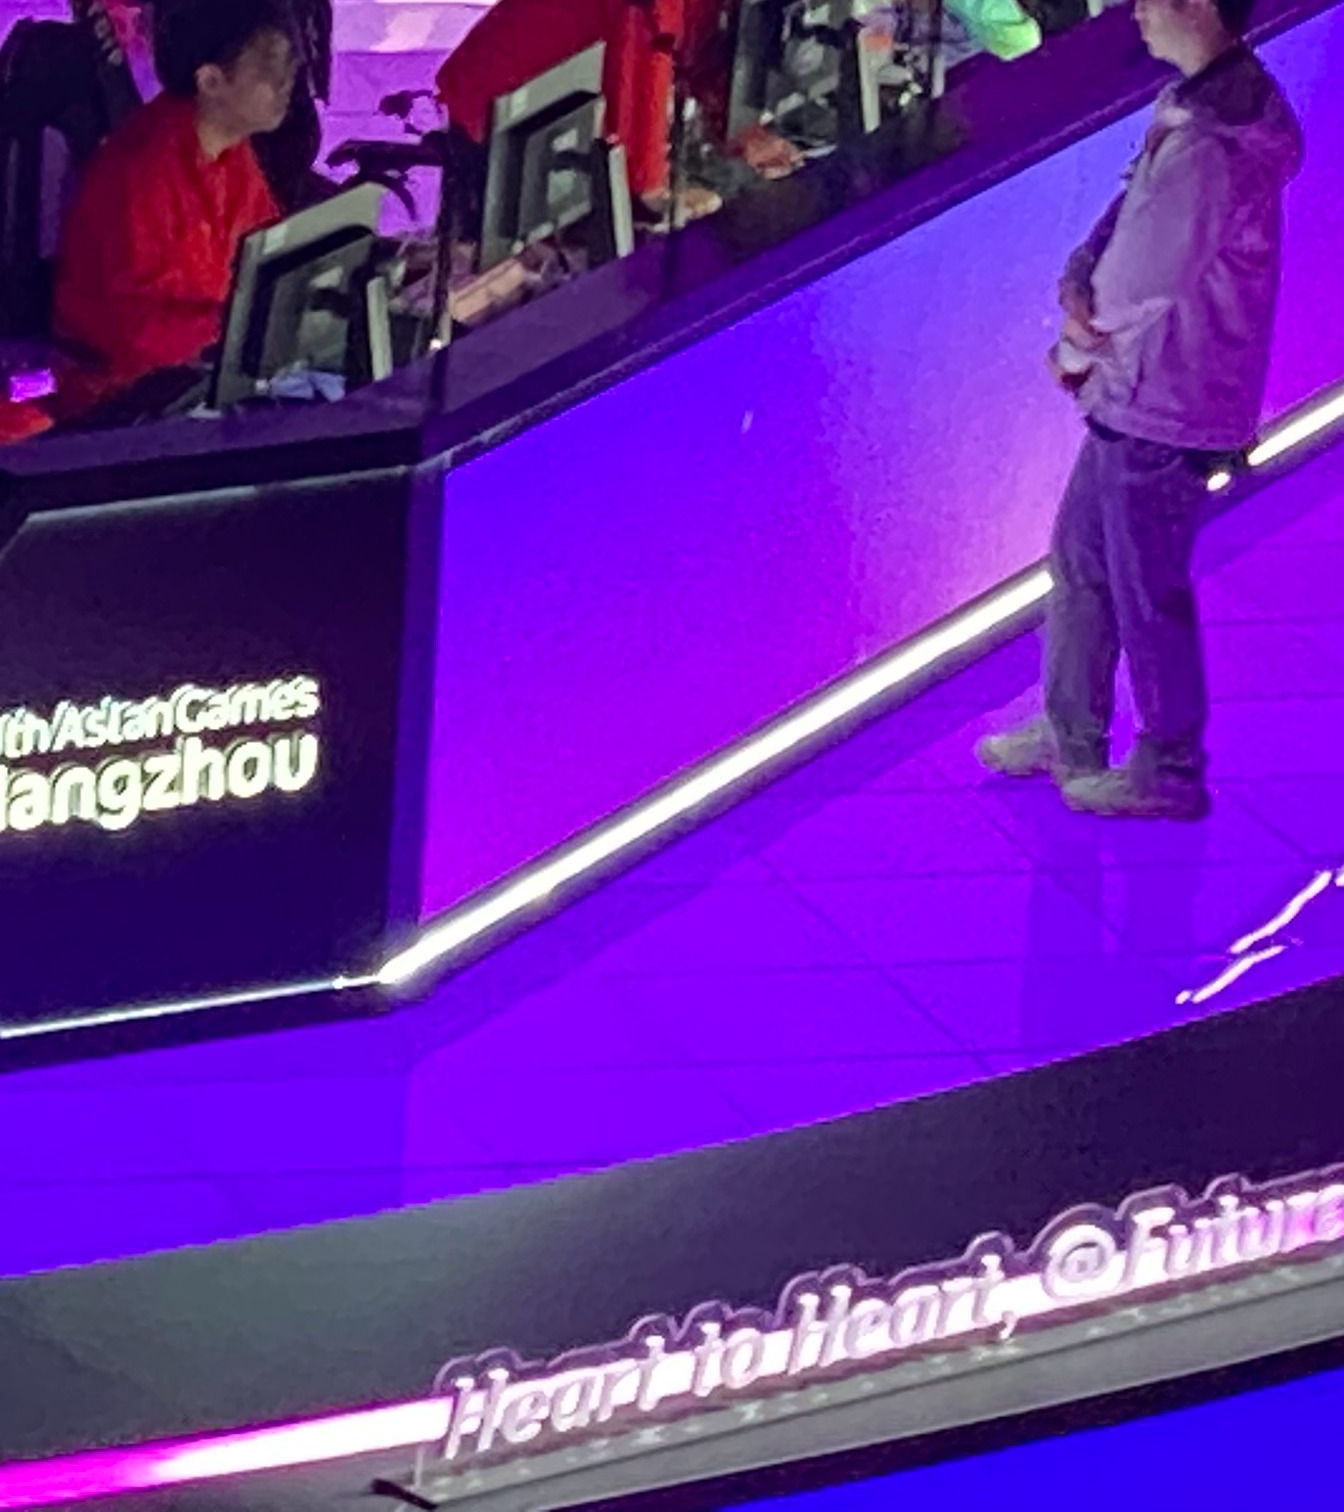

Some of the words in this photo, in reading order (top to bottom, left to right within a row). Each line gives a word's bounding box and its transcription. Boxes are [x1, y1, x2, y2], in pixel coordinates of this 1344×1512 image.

[53, 696, 175, 751] Asian
[173, 674, 320, 733] Games
[444, 1334, 666, 1461] Heart
[694, 1321, 765, 1397] to
[785, 1253, 1019, 1375] Heart,
